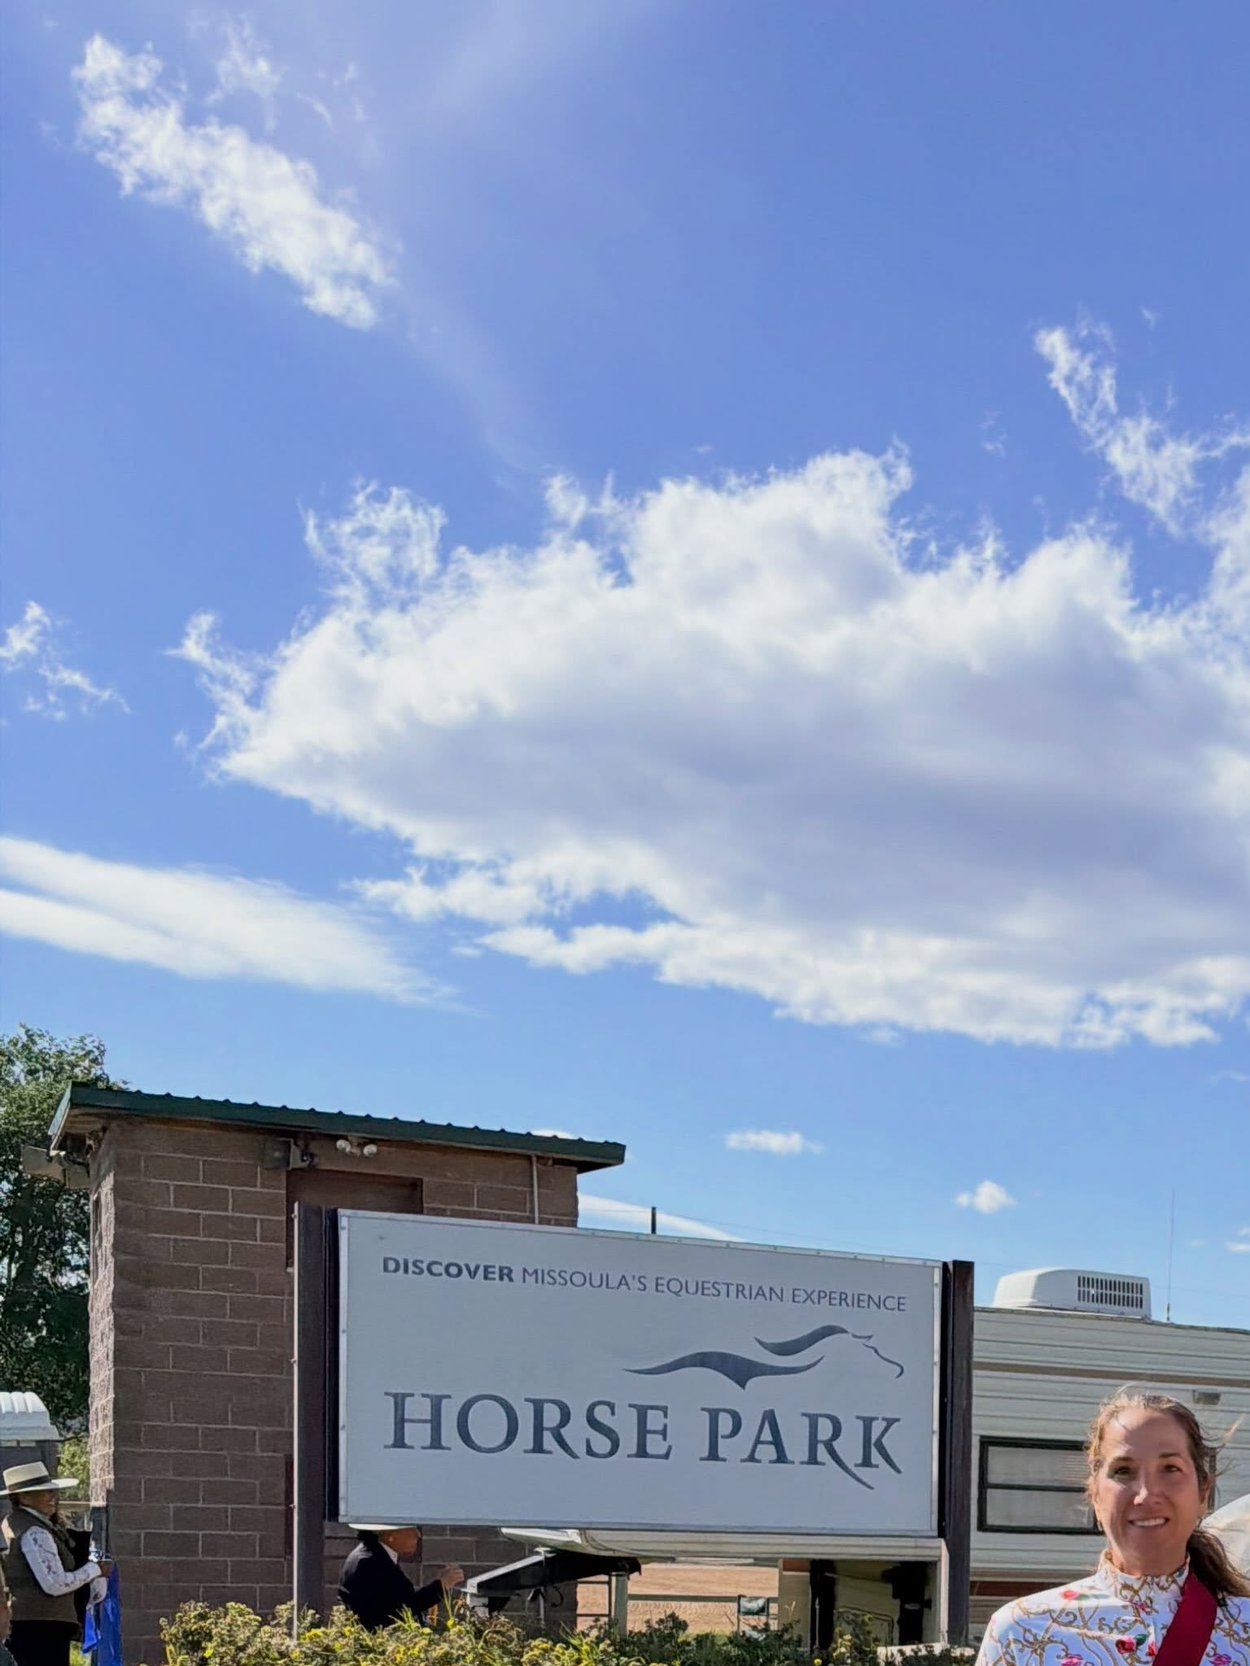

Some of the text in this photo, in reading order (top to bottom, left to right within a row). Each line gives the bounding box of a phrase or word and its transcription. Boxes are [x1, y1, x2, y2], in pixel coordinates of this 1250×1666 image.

[383, 1257, 907, 1312] DISCOVER MISSOULA'S EQUESTRIAN EXPERIENCE
[384, 1391, 903, 1490] HORSE PARK
